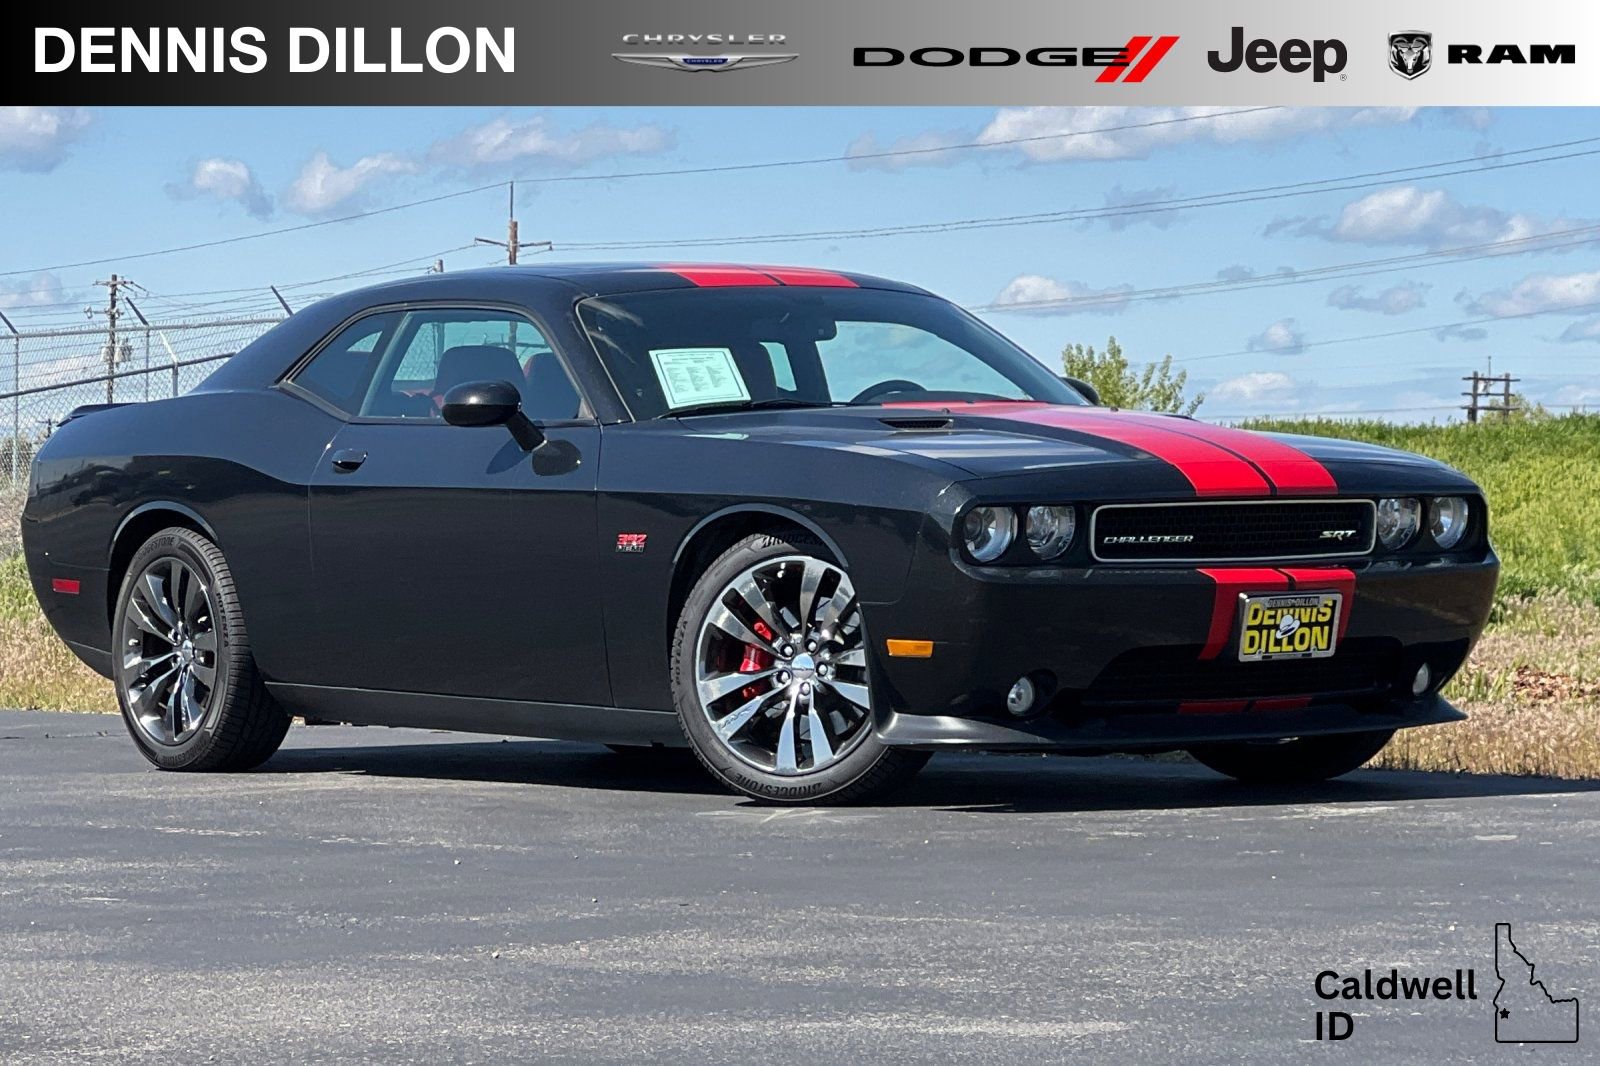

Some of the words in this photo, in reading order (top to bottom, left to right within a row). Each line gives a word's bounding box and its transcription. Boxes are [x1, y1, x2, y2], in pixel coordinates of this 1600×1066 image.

[1103, 534, 1194, 545] CHALLENGER
[1319, 529, 1356, 541] SRT
[1243, 626, 1330, 654] DILLON
[734, 772, 823, 797] BRIDGESTONE
